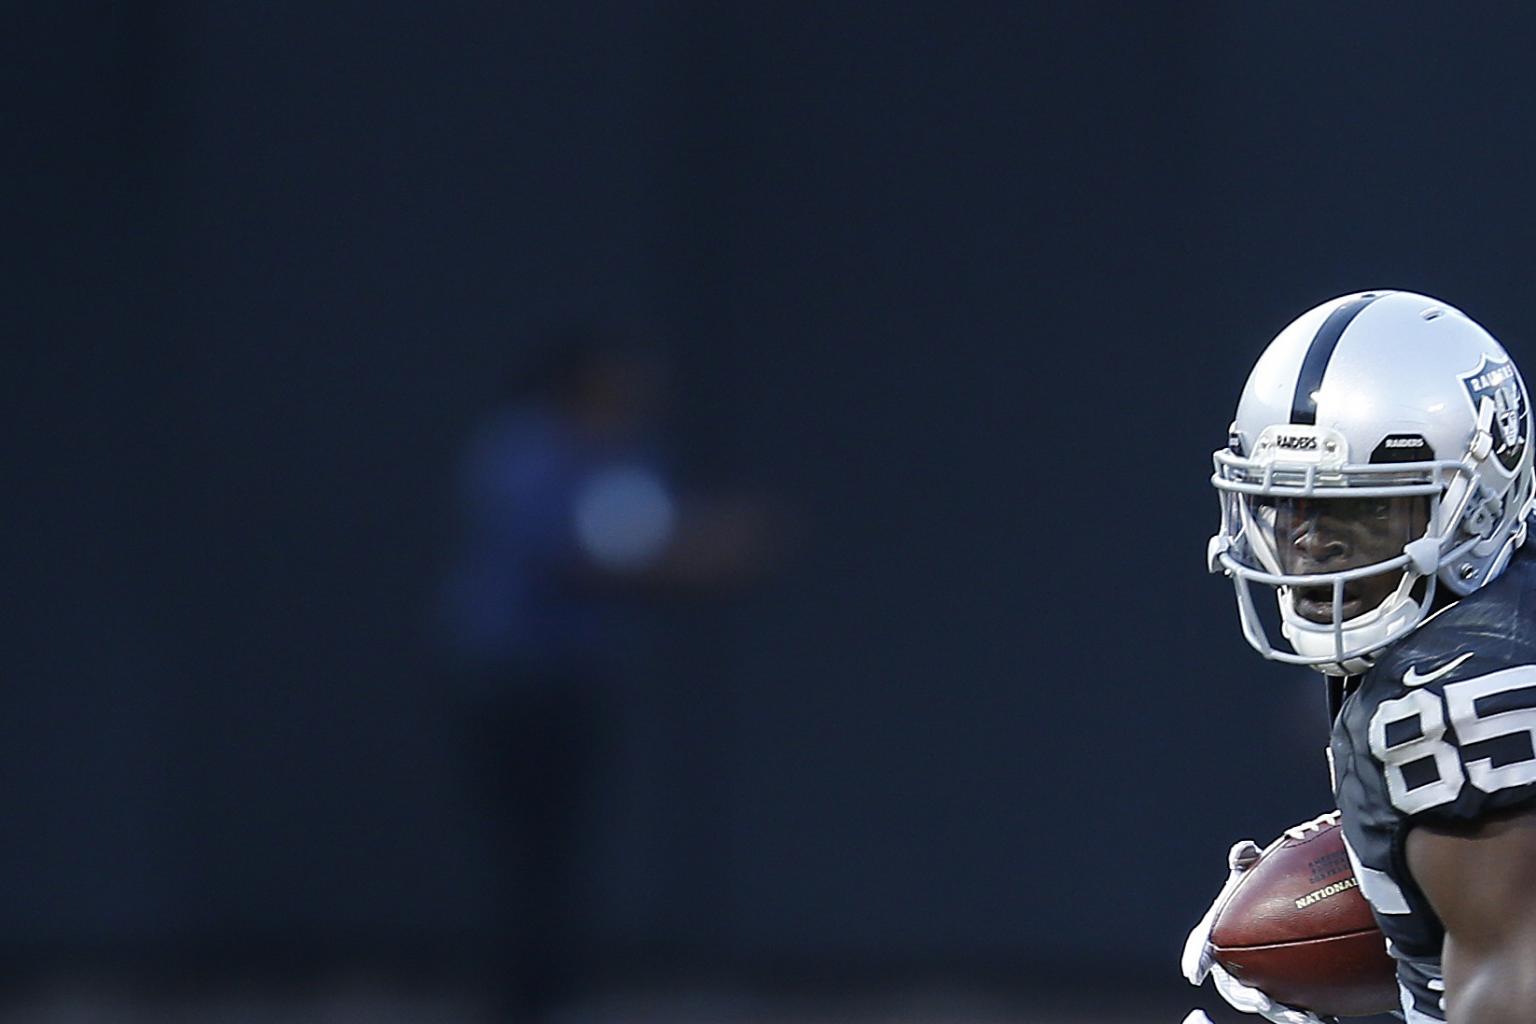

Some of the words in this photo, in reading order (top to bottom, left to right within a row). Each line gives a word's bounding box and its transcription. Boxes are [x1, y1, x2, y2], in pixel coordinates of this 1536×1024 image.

[1470, 364, 1514, 392] RAIRS
[1384, 438, 1424, 448] RAIDERS
[1295, 877, 1360, 909] NATIONAL
